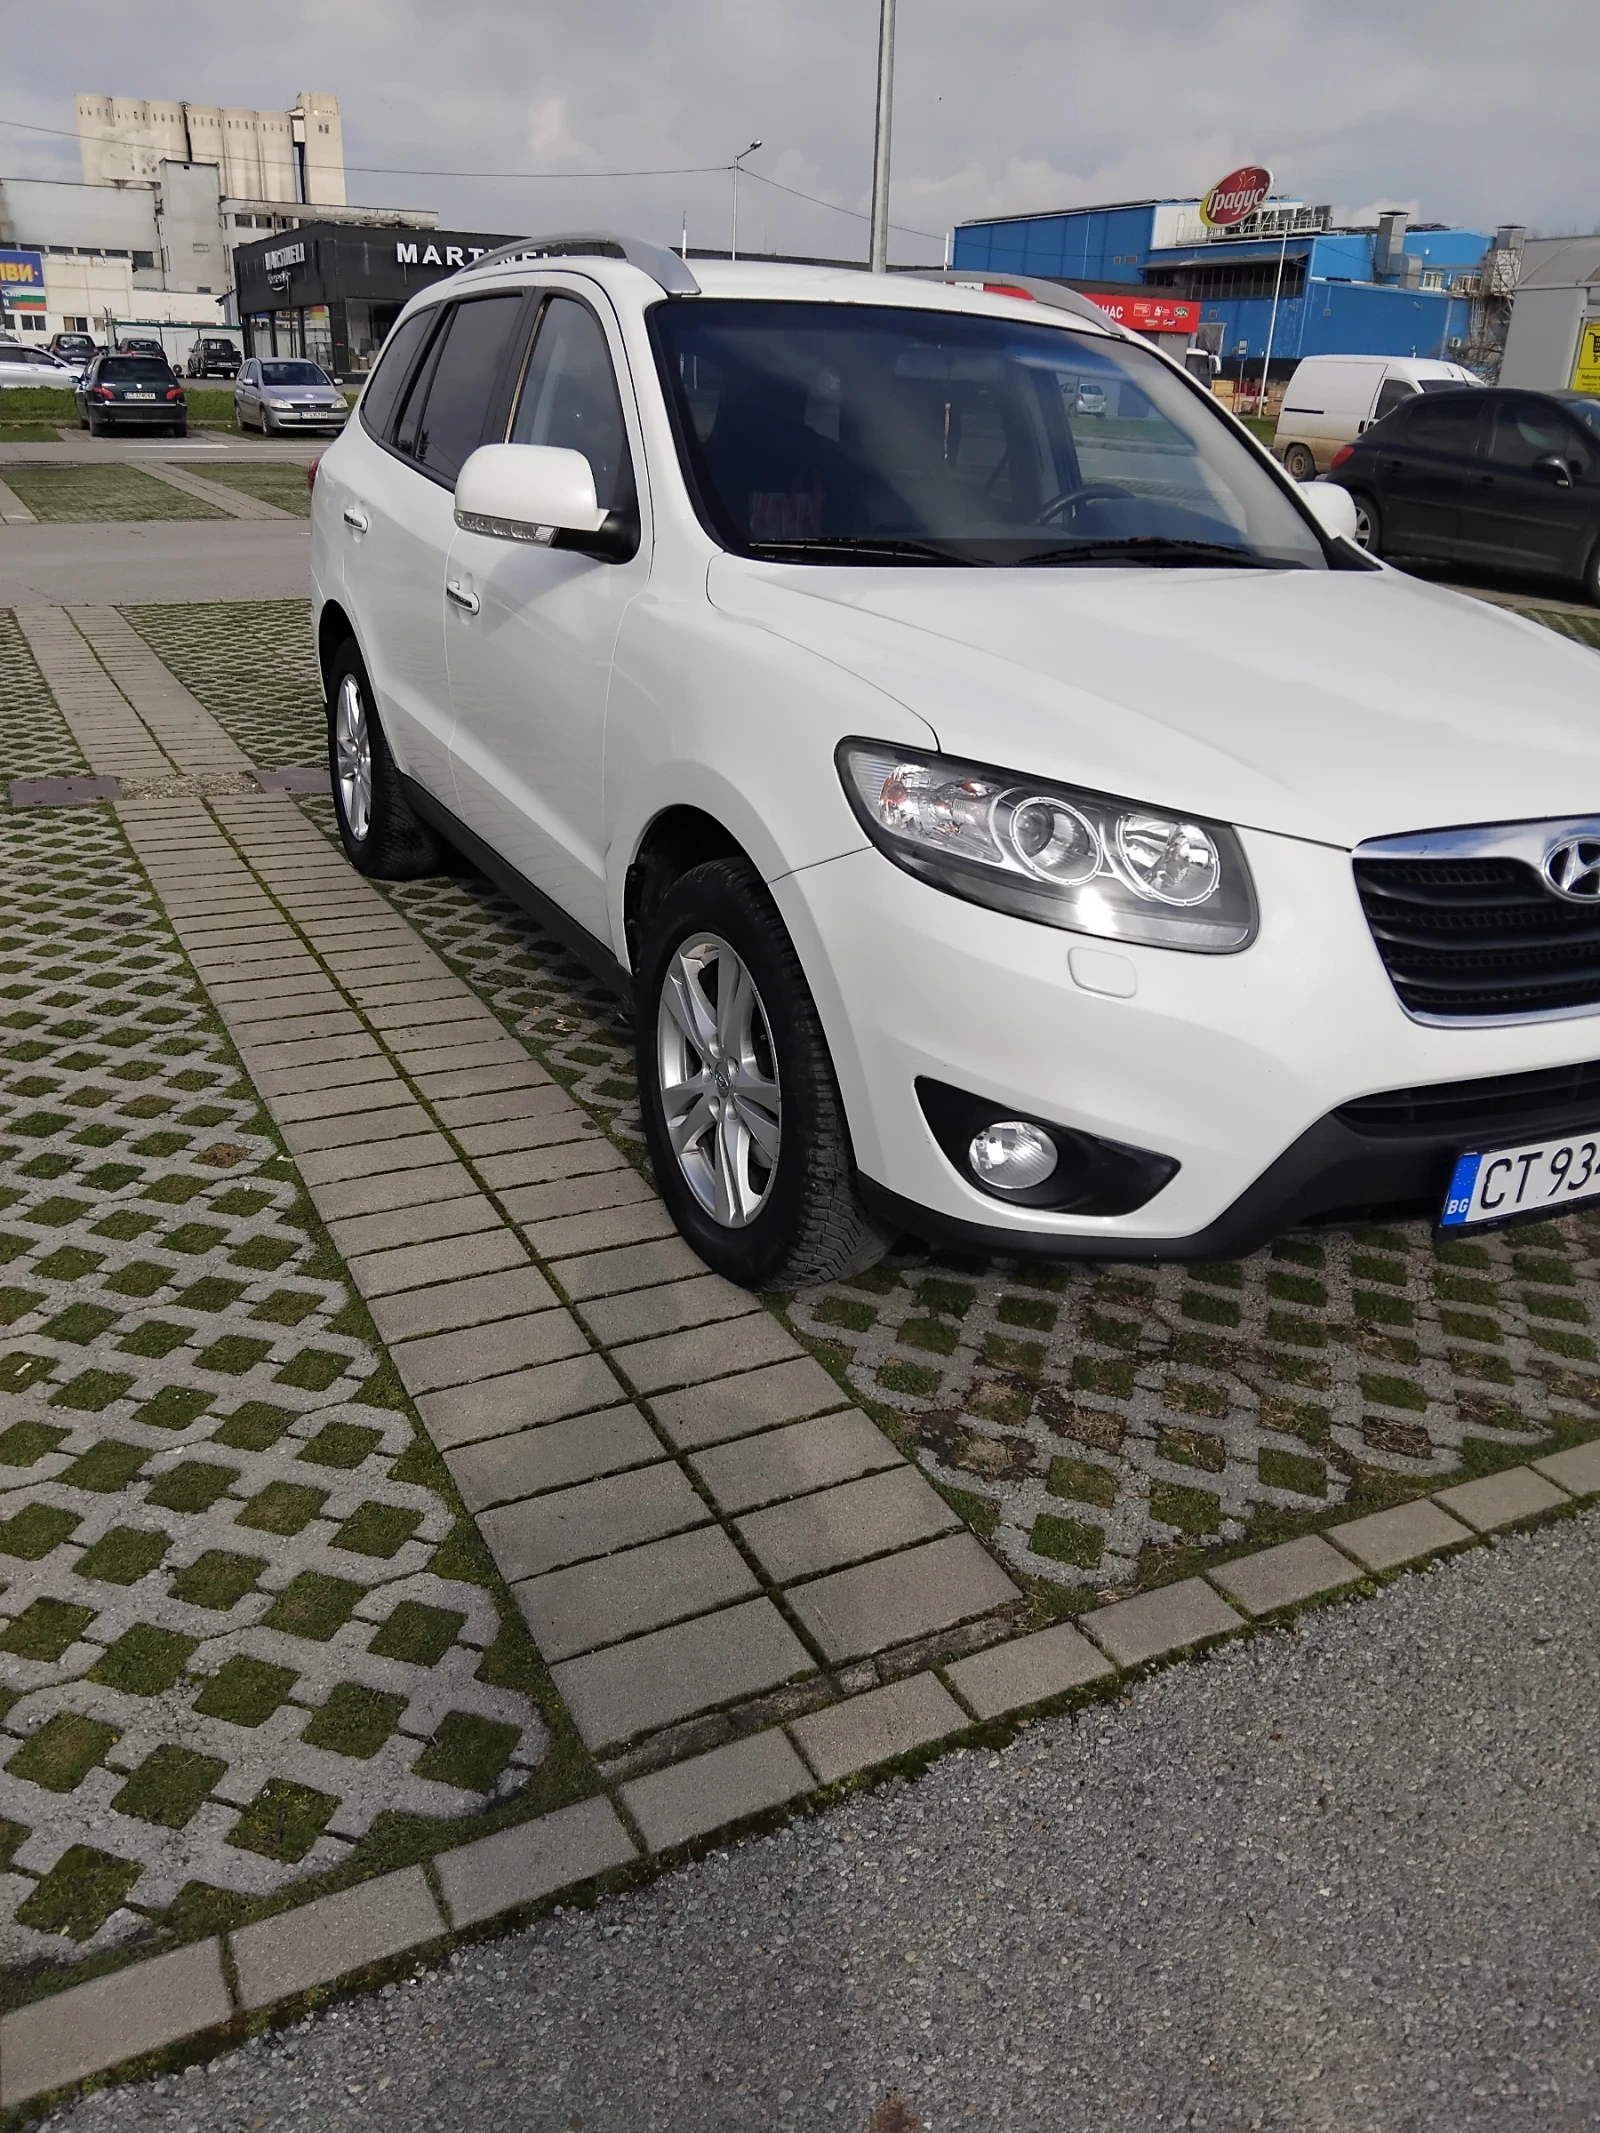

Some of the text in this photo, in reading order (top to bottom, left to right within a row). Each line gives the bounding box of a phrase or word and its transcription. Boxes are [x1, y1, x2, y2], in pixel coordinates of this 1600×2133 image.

[1207, 188, 1265, 219] Градус
[1547, 1142, 1600, 1197] 93
[1447, 1199, 1469, 1215] BG
